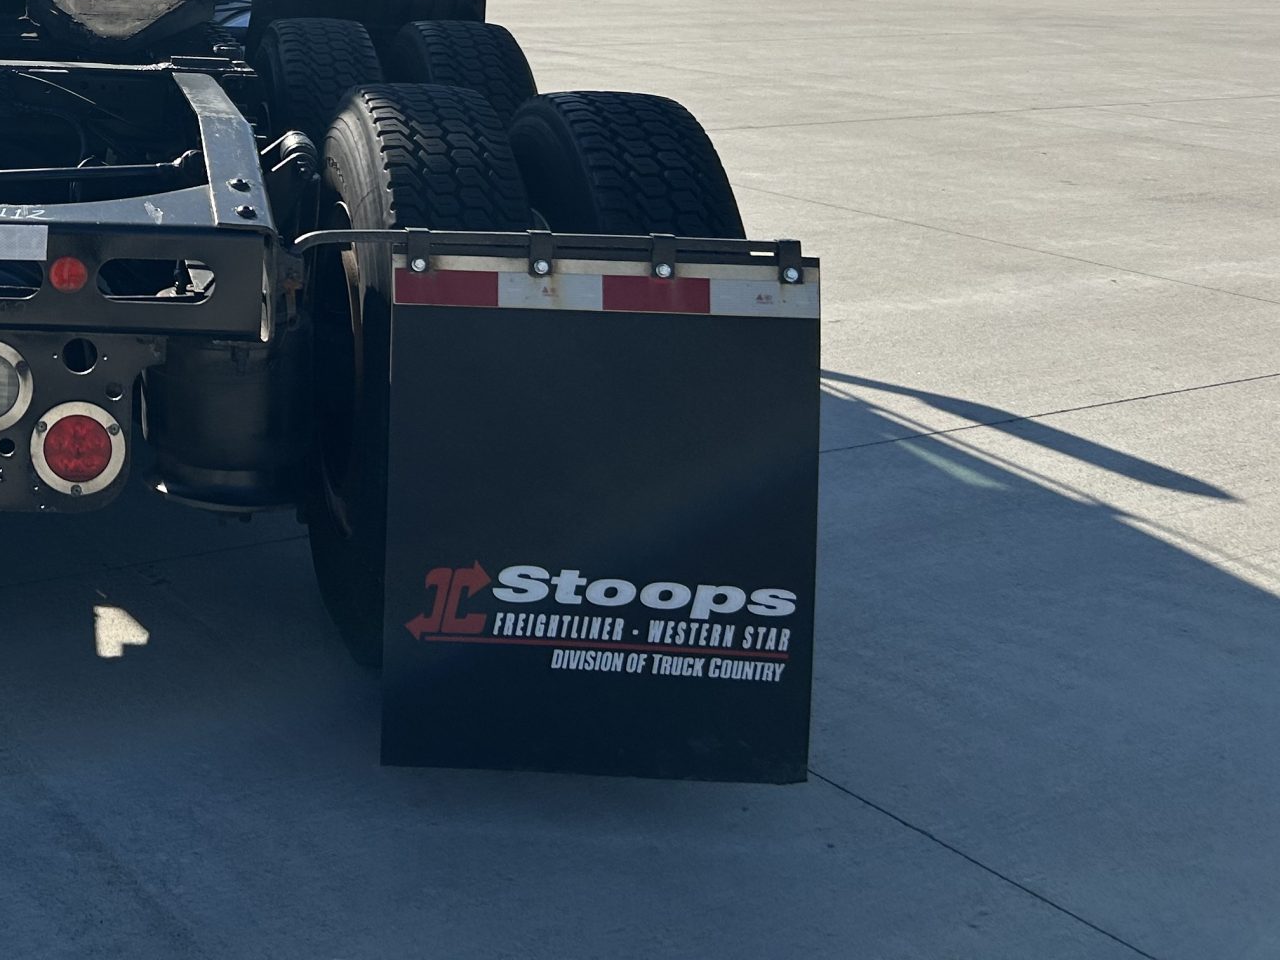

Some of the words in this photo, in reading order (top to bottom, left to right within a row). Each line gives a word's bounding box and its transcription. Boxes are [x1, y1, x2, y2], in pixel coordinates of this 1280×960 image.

[492, 565, 797, 620] Stoops
[492, 612, 625, 641] FREIGHTLINER
[647, 619, 736, 648] WESTERN
[742, 625, 791, 652] STAR
[551, 649, 624, 672] DIVISION
[625, 652, 648, 674] OF
[651, 653, 706, 678] TRUCK
[708, 657, 786, 682] COUNTRY
